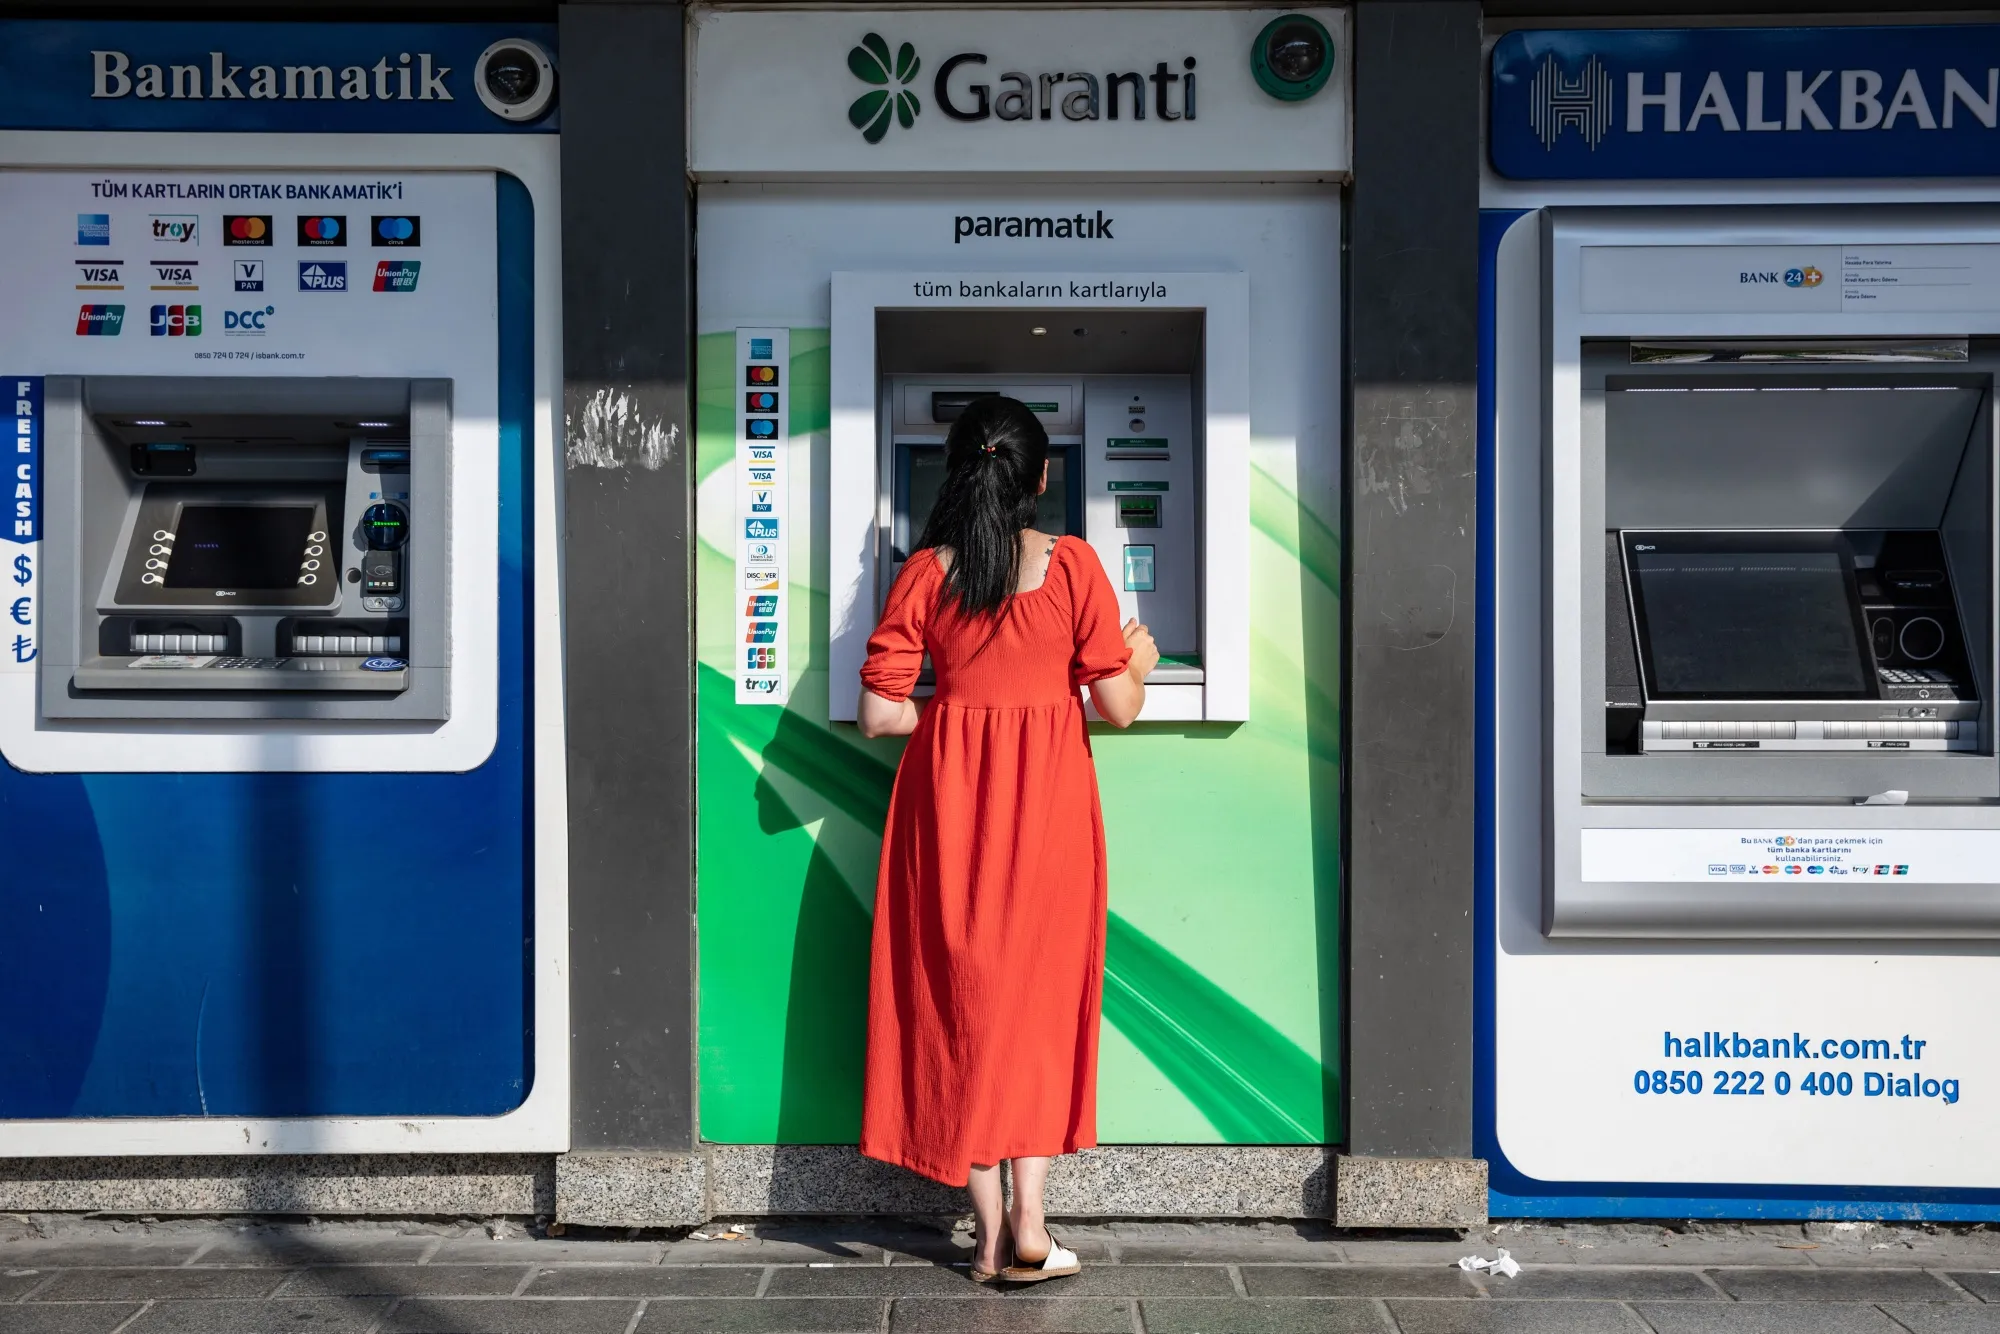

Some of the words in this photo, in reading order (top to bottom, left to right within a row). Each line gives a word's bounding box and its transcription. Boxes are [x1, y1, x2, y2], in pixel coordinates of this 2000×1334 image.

[90, 50, 455, 101] Bankamatik
[933, 52, 1197, 122] Garanti
[91, 179, 127, 198] TÜM
[132, 183, 225, 199] KARTLARIN
[229, 184, 283, 200] ORTAK
[153, 219, 195, 243] troy
[954, 210, 1114, 244] paramatık
[81, 268, 119, 281] VISA
[156, 268, 192, 281] VISA
[240, 264, 256, 278] V
[377, 268, 418, 279] UnionPay
[1740, 272, 1779, 284] BANK
[241, 281, 257, 289] PAY
[312, 275, 345, 289] PLUS
[913, 282, 953, 298] tüm
[959, 281, 1063, 298] bankaların
[1069, 281, 1168, 303] kartlarıyla
[80, 311, 122, 324] UnionPay
[224, 310, 266, 329] DCC
[194, 352, 211, 360] 0850
[213, 351, 227, 360] 724
[228, 351, 234, 360] 0
[236, 351, 250, 360] 724
[255, 352, 305, 360] isbank.com.tr
[15, 381, 33, 453] FREE
[752, 450, 773, 459] VISA
[752, 472, 772, 480] VISA
[14, 463, 33, 536] CASH
[756, 491, 768, 503] V
[755, 528, 777, 537] PLUS
[749, 600, 776, 608] UnionPay
[748, 628, 776, 637] UnionPay
[745, 677, 779, 694] troy
[1664, 1031, 1927, 1060] halkbank.com.tr
[1633, 1070, 1704, 1095] 0850
[1713, 1070, 1765, 1096] 222
[1774, 1071, 1792, 1096] 0
[1800, 1071, 1853, 1097] 400
[1863, 1072, 1960, 1106] Dialog
